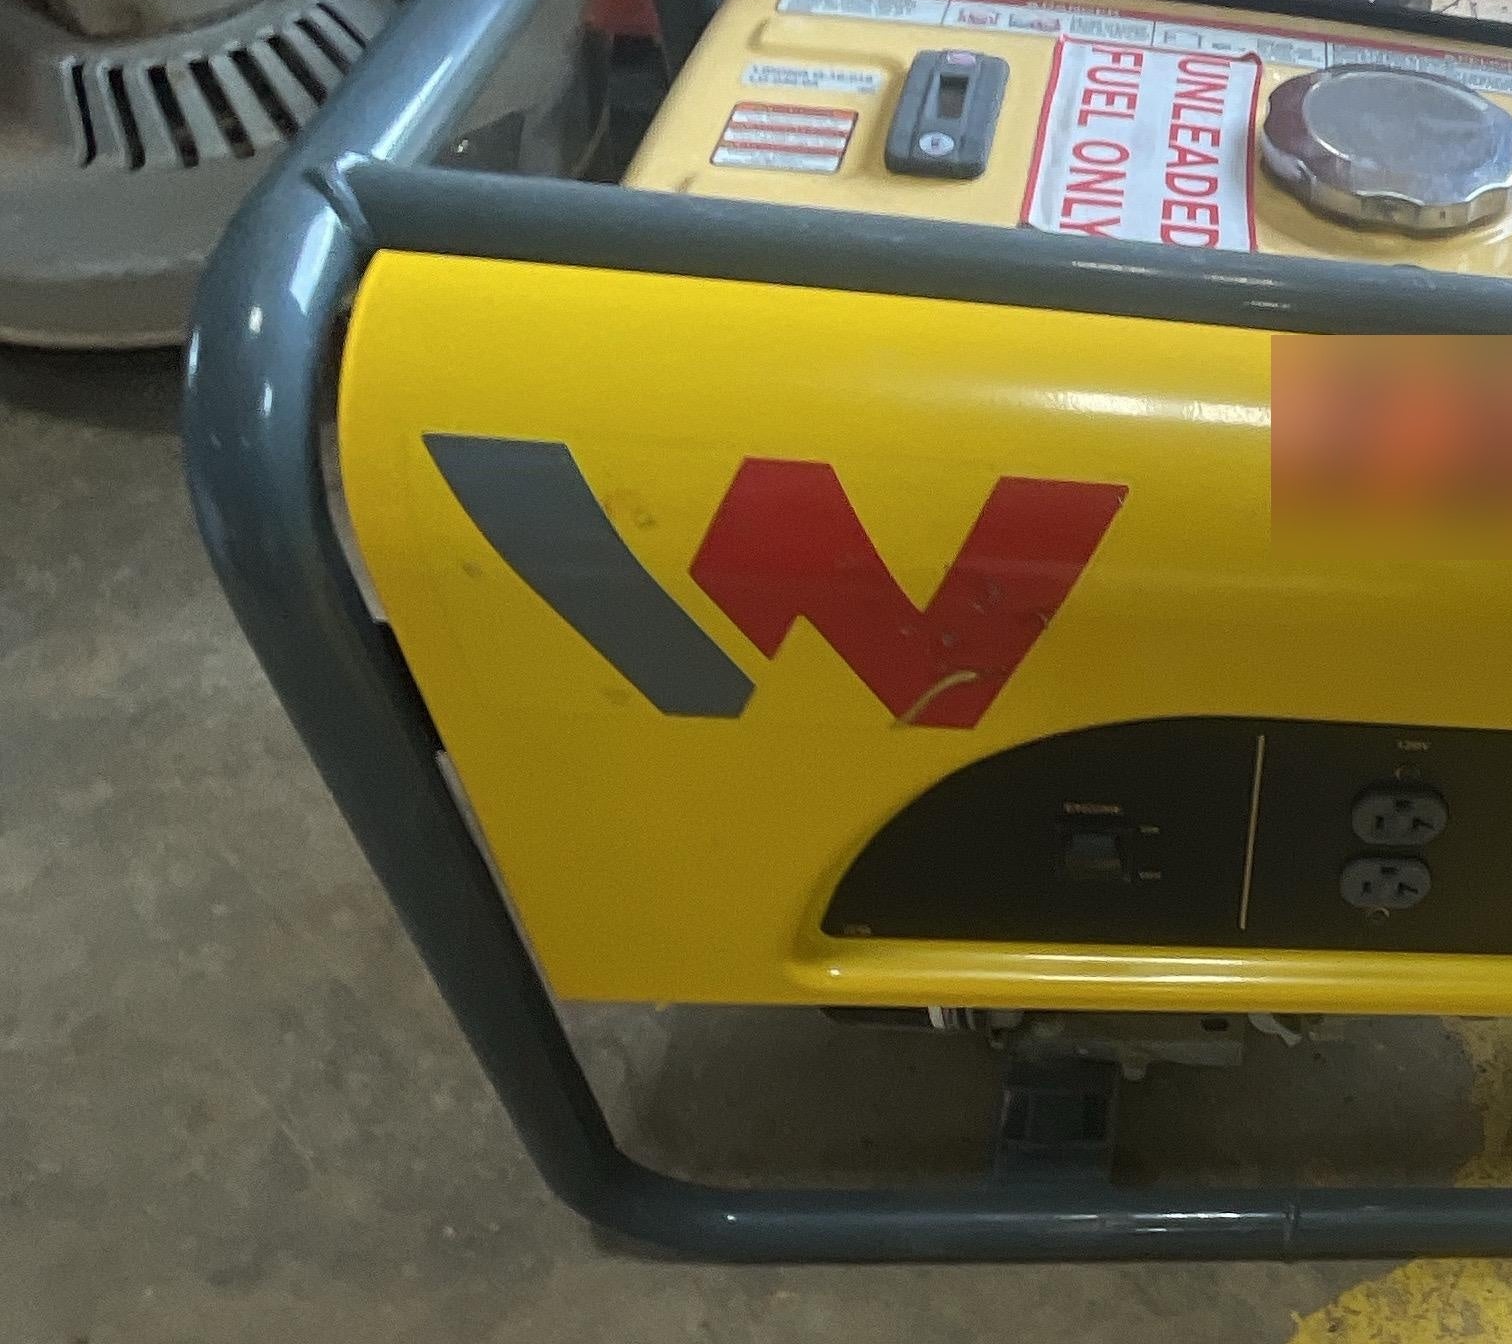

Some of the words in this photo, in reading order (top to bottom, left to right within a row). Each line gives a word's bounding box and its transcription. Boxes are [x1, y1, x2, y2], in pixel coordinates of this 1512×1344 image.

[1077, 46, 1144, 127] FUEL
[1059, 139, 1130, 240] ONLY
[1160, 55, 1231, 248] UNLEADED
